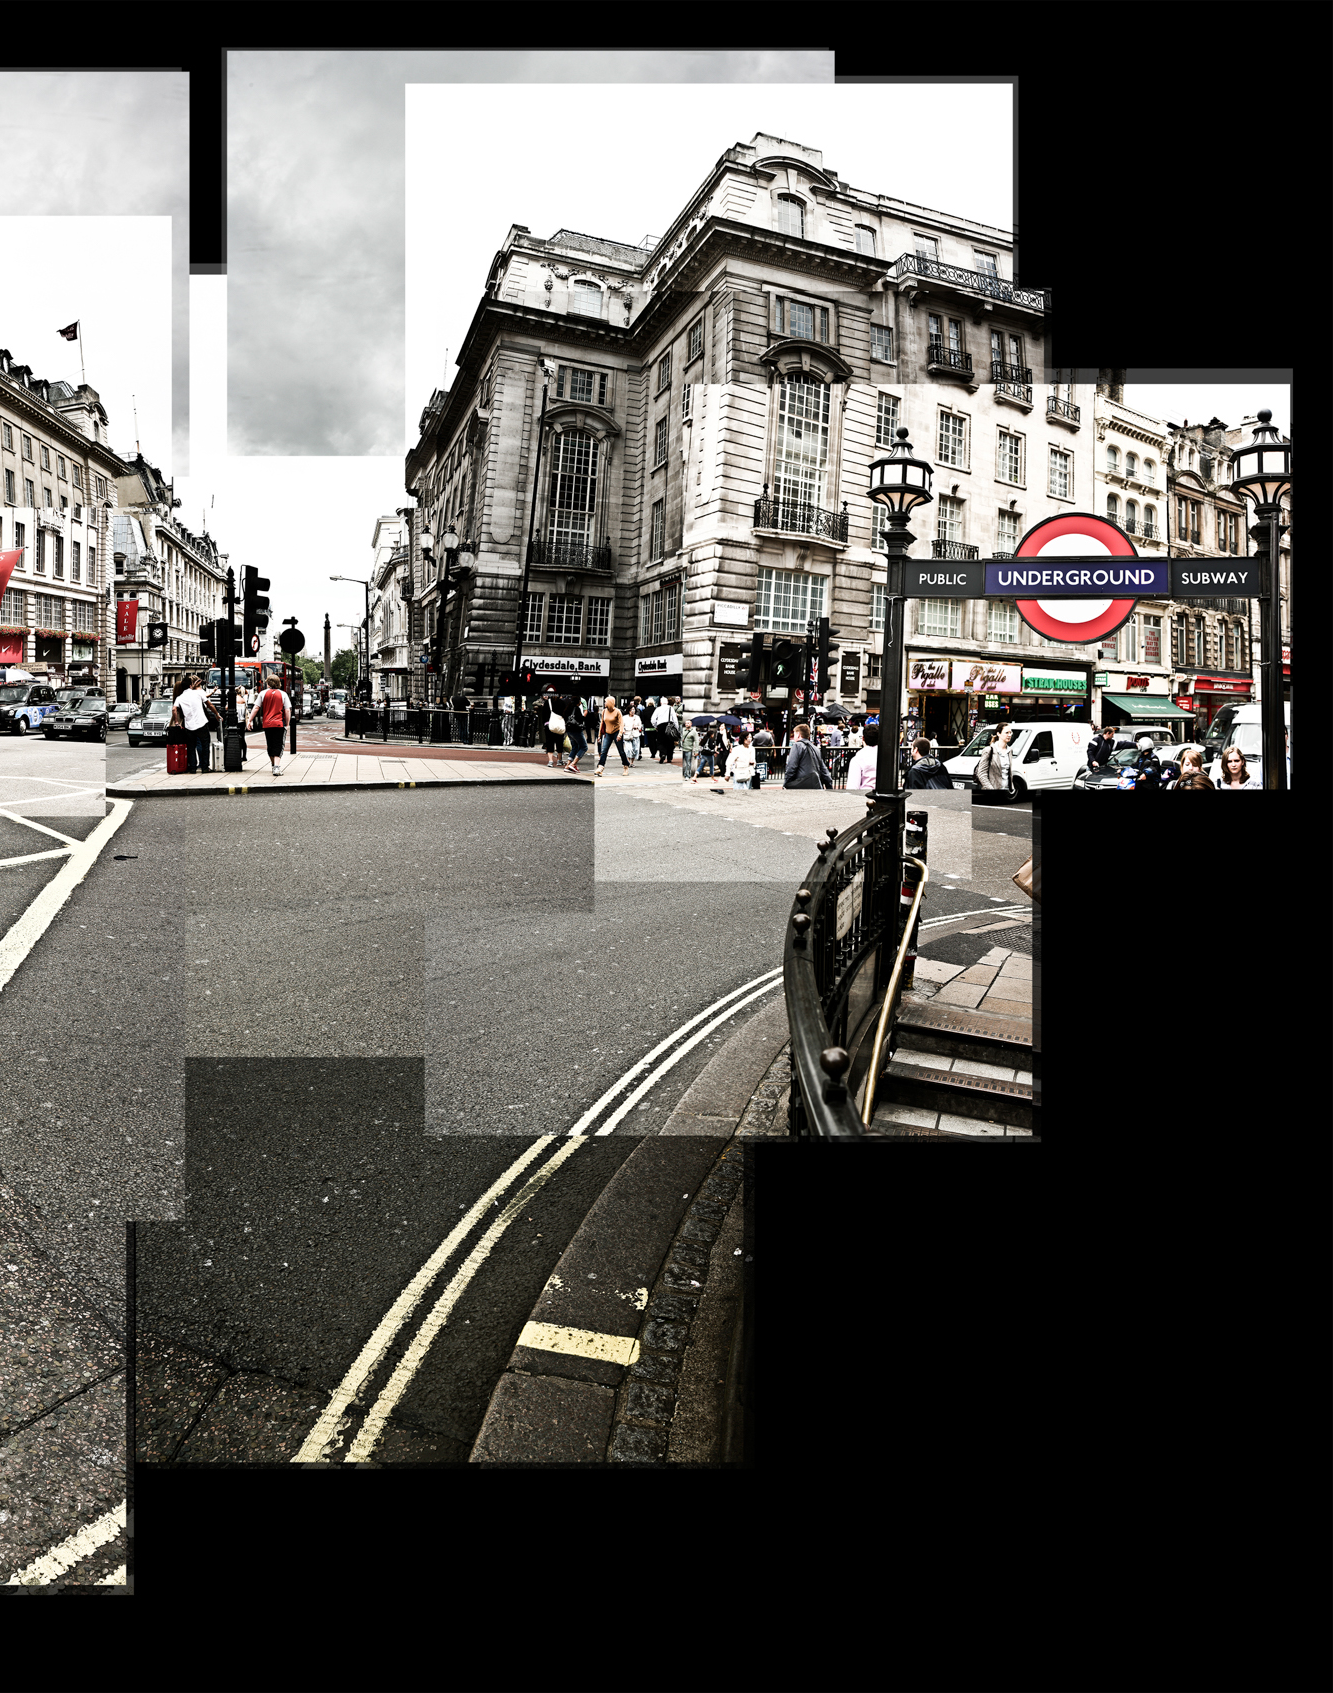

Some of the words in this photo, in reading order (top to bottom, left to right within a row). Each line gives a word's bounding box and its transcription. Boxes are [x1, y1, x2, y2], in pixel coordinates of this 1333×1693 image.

[919, 573, 967, 586] PUBLIC
[998, 570, 1155, 586] UNDERGROUND
[1181, 572, 1248, 585] SUBWAY
[523, 659, 574, 670] Clydesdale
[578, 661, 601, 671] Bank
[912, 663, 945, 688] Pigalle
[970, 664, 1006, 690] Pigalle
[1026, 677, 1055, 689] STEAK
[1056, 679, 1087, 690] HOUSES
